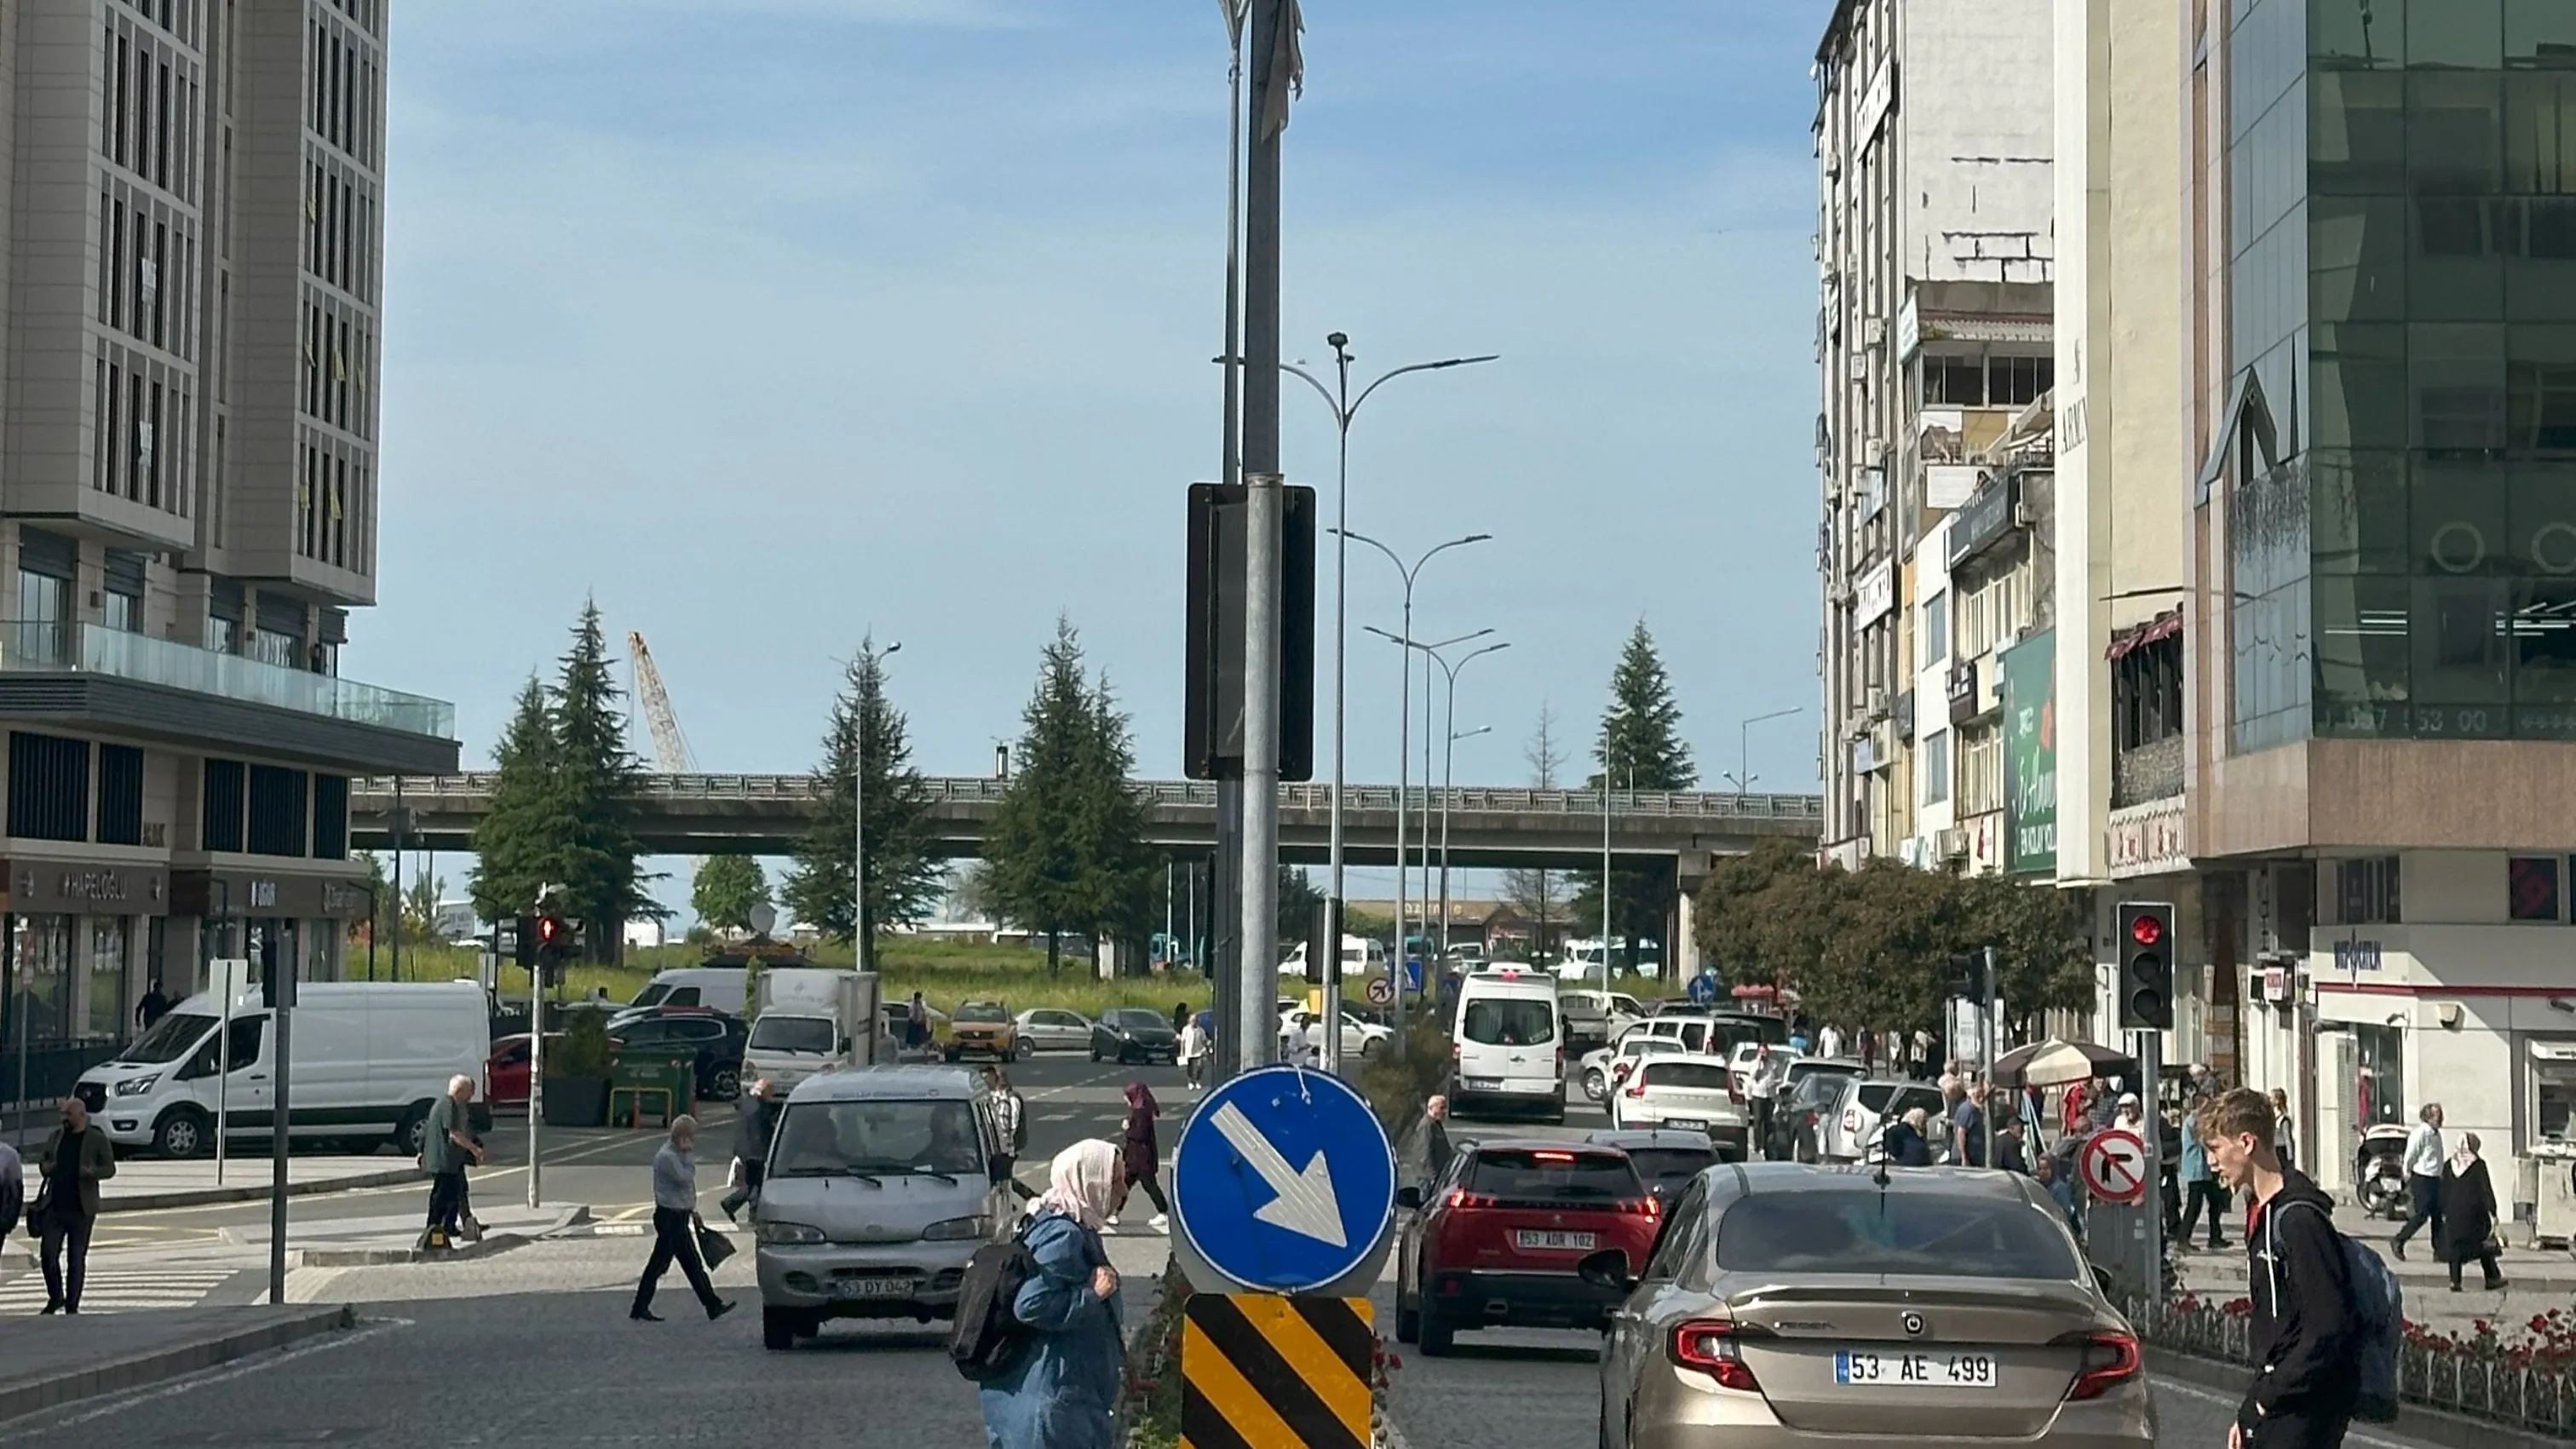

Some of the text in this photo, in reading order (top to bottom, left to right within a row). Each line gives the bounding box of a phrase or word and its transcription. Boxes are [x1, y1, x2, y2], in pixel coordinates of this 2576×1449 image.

[1852, 1355, 1990, 1382] 53 AE 499
